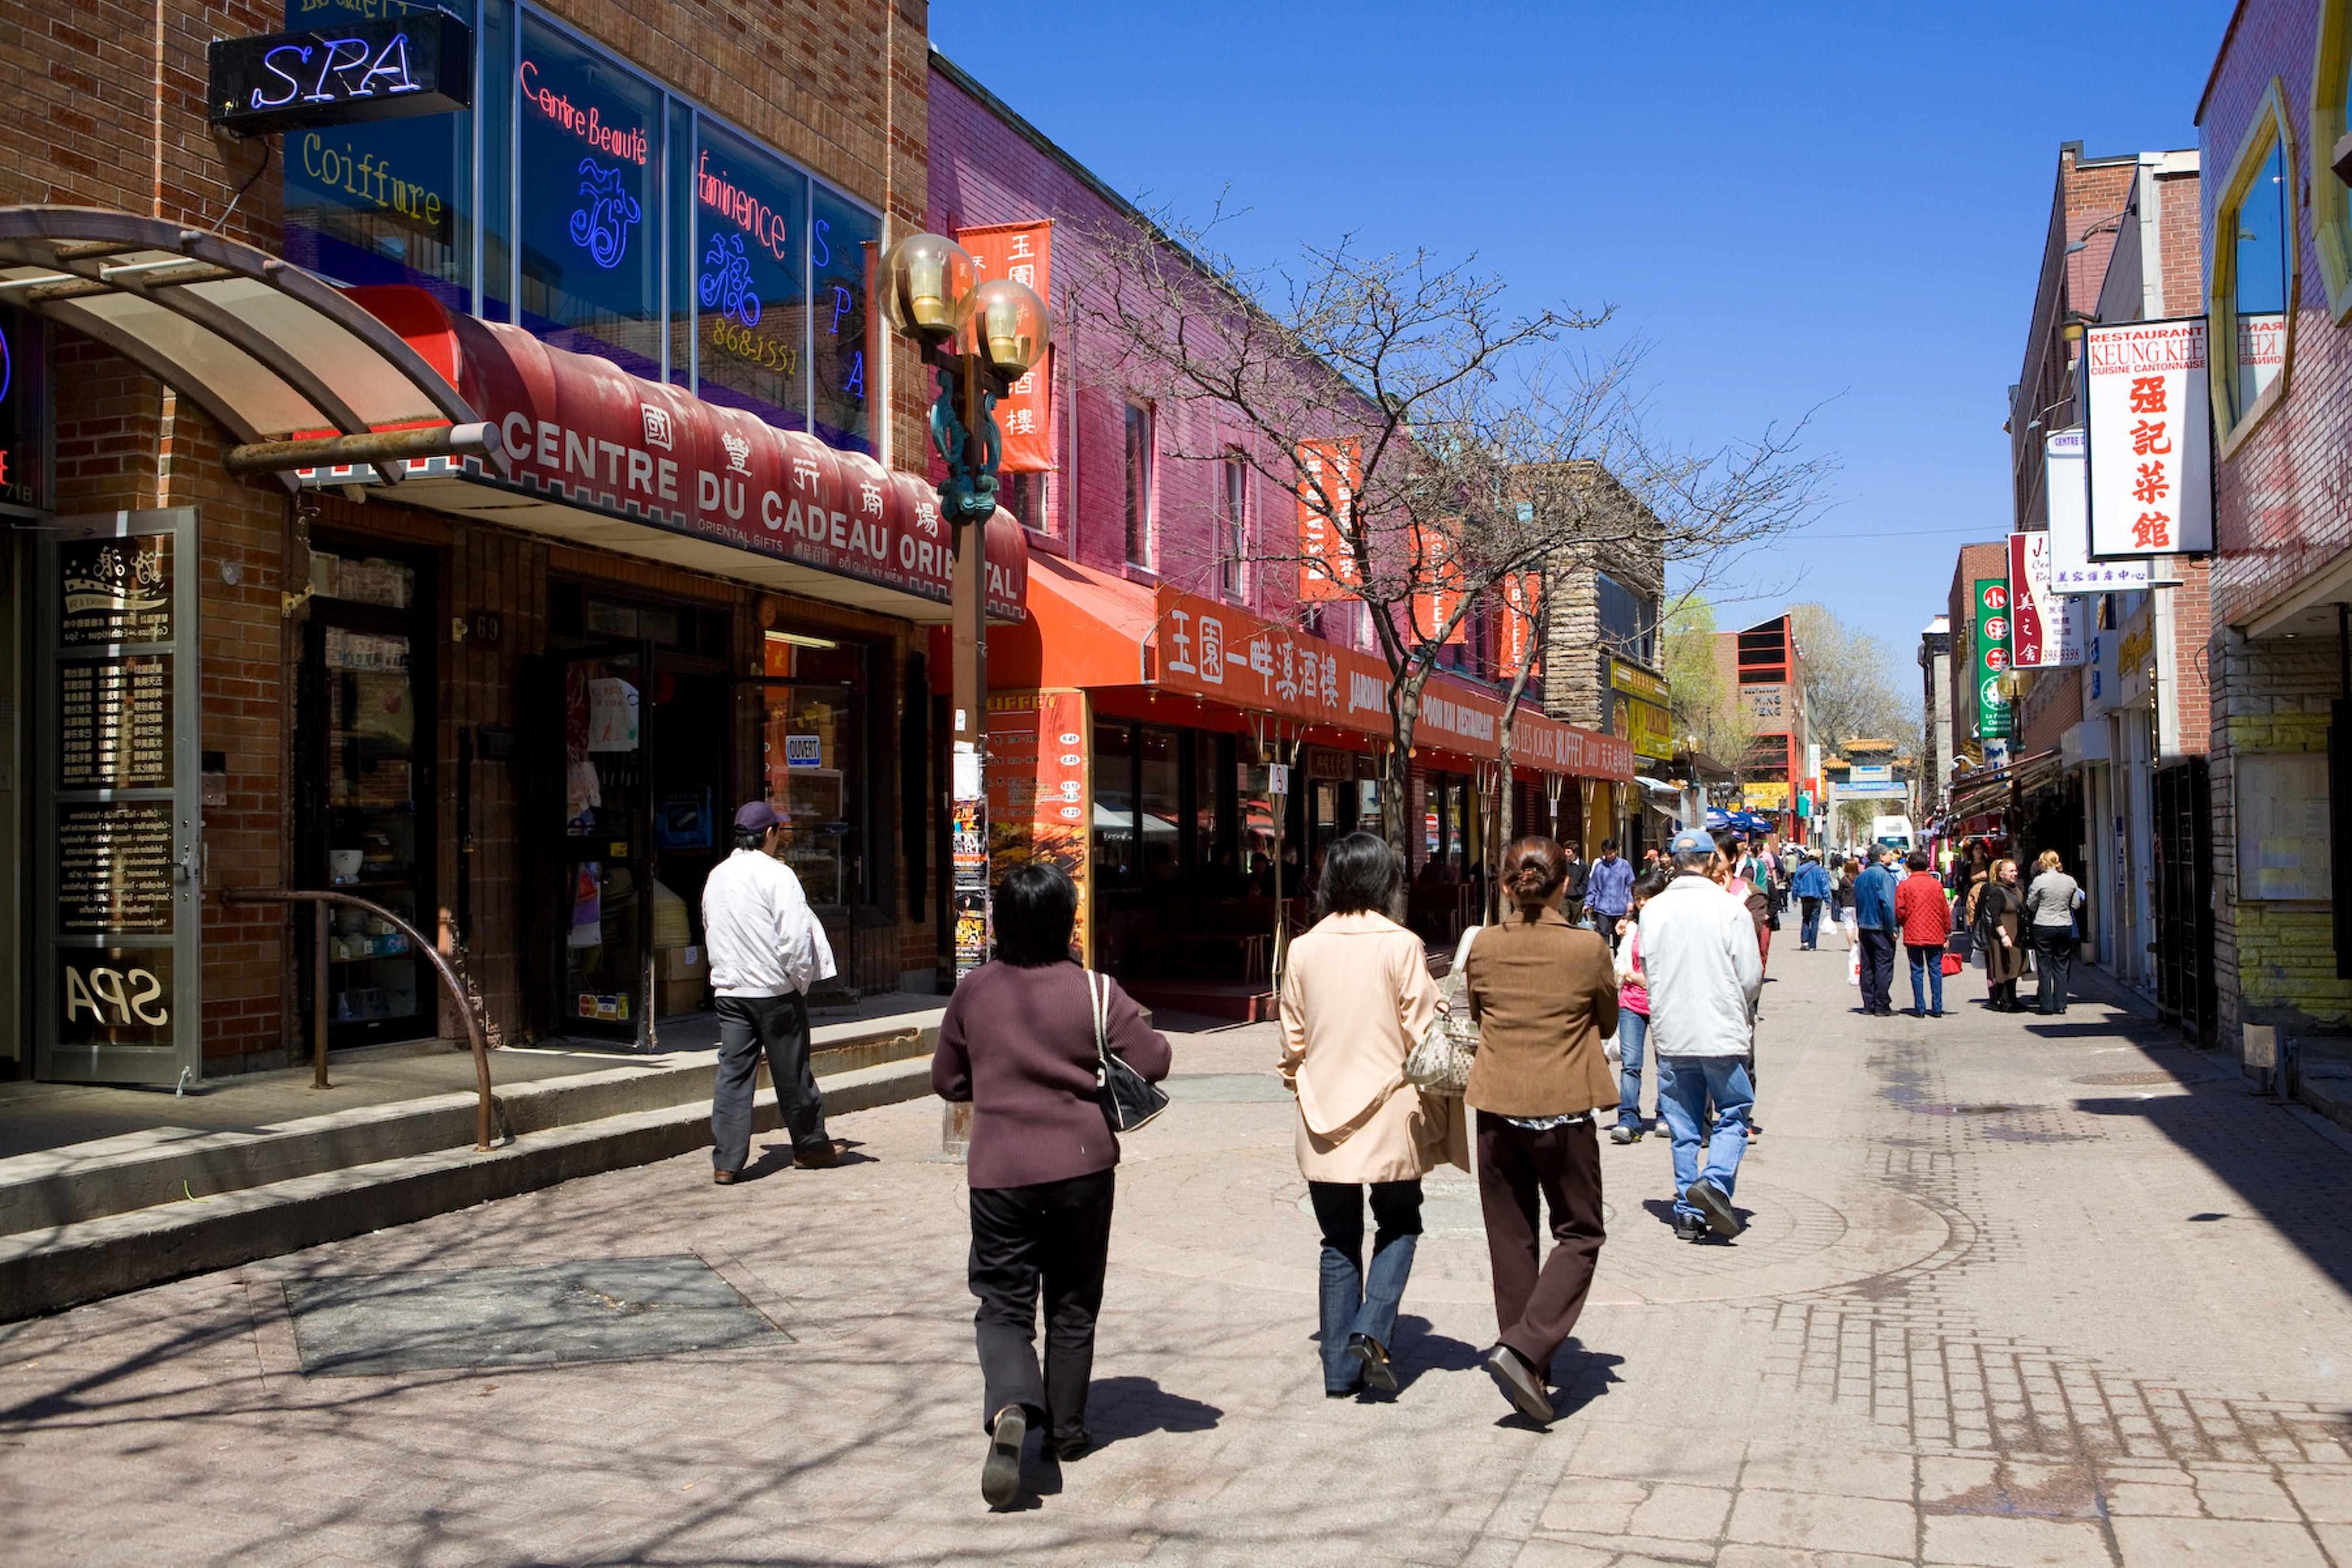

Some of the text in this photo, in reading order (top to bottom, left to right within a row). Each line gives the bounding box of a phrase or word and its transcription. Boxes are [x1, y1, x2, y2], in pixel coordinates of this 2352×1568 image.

[252, 33, 421, 109] SPA
[520, 61, 647, 165] Centre Beauté
[304, 132, 440, 225] Coiffure
[698, 150, 785, 259] Éminence
[713, 318, 797, 375] 868-1551
[2090, 327, 2204, 343] RESTAURANT
[2091, 338, 2204, 366] KEUNG KEE
[2091, 359, 2205, 375] CUISINE CANTONNAISE
[2055, 436, 2079, 446] CENTRE
[502, 411, 1017, 600] CENTRE DU CADEAU ORIETAL
[698, 518, 783, 552] ORIENTAL GIFTS
[477, 616, 498, 641] 69
[1349, 671, 1383, 714] JARDIN
[1423, 694, 1443, 729] POON
[790, 740, 818, 758] OUVERT
[1556, 728, 1584, 767] BUFFET
